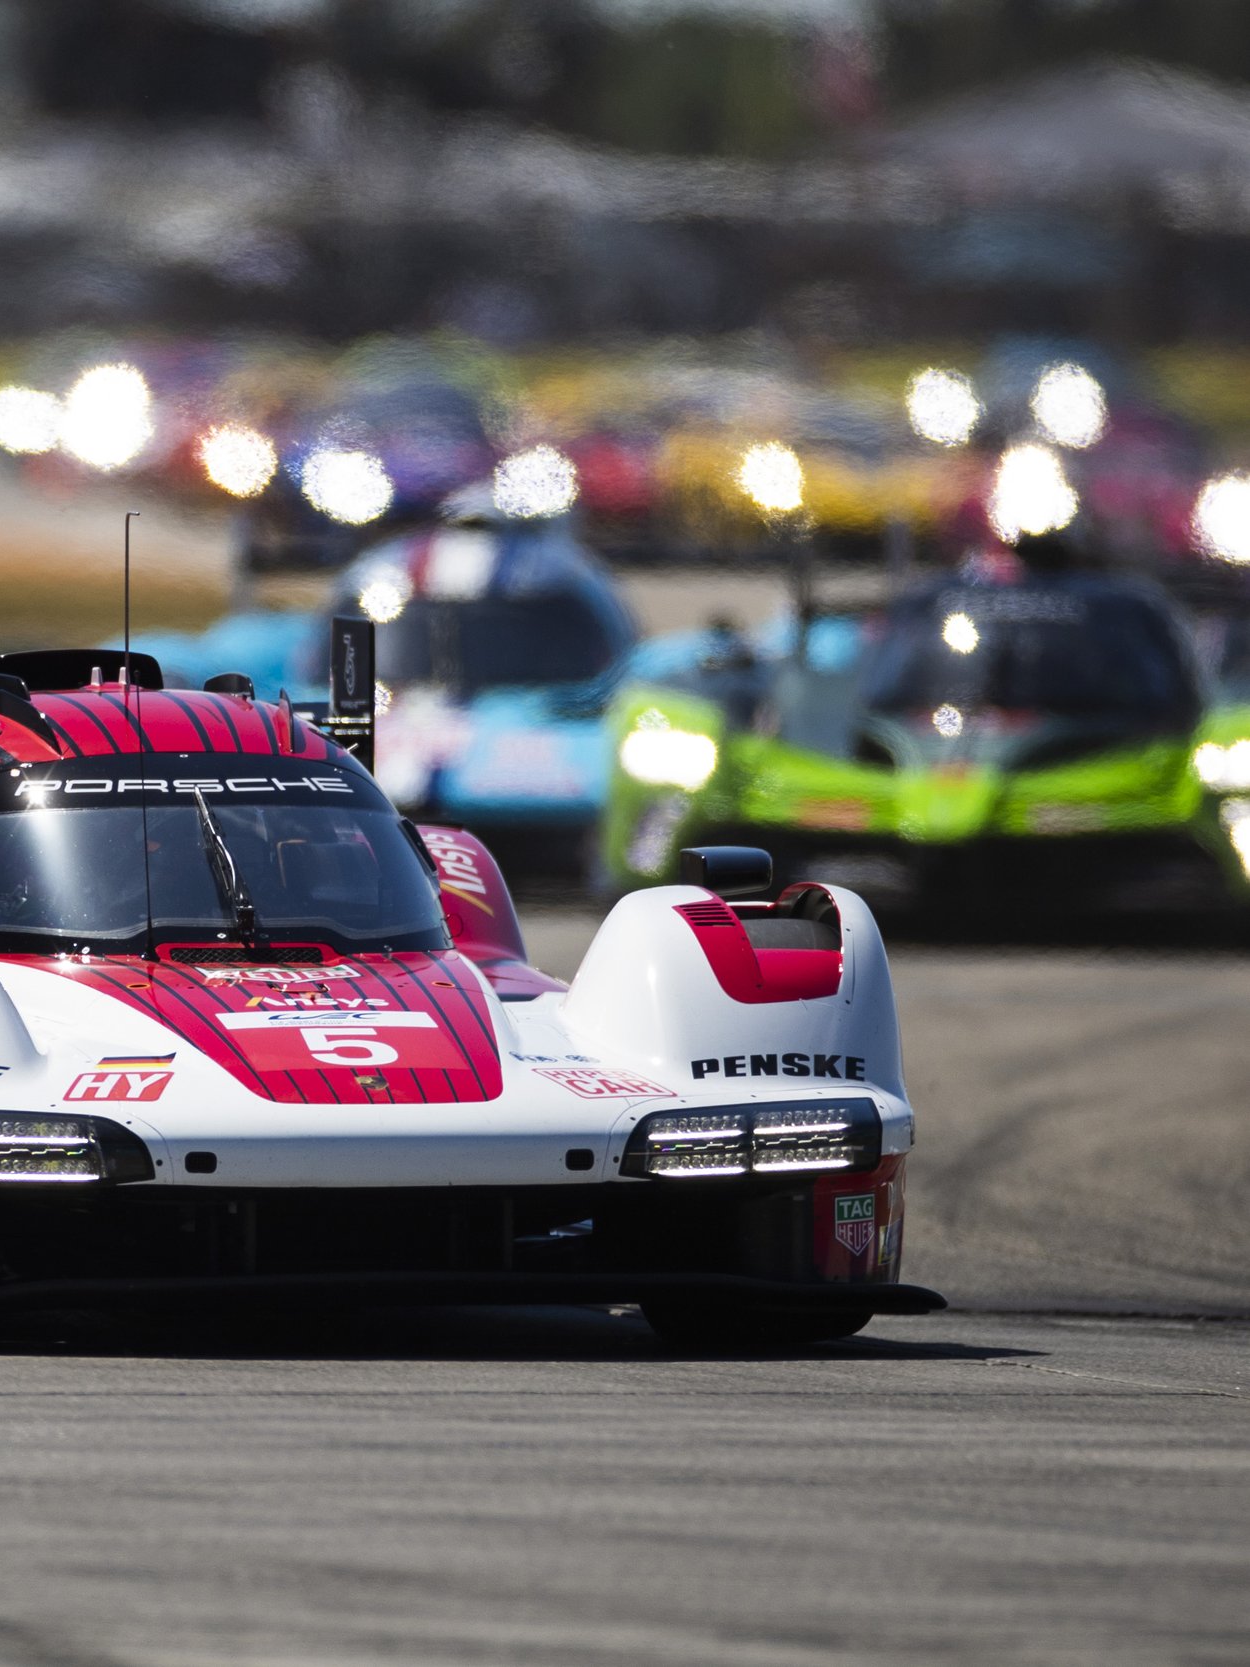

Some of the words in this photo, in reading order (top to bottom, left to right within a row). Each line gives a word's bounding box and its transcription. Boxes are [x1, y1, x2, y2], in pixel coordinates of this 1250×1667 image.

[14, 777, 354, 797] PORSCHE
[421, 833, 494, 917] Ansys
[245, 996, 390, 1008] Ansys
[300, 1027, 399, 1066] 5
[543, 1070, 639, 1080] HYPER
[691, 1052, 866, 1082] PENSKE
[68, 1073, 168, 1098] HY
[565, 1079, 664, 1095] CAR
[839, 1199, 872, 1218] TAG
[838, 1221, 873, 1250] HEUER
